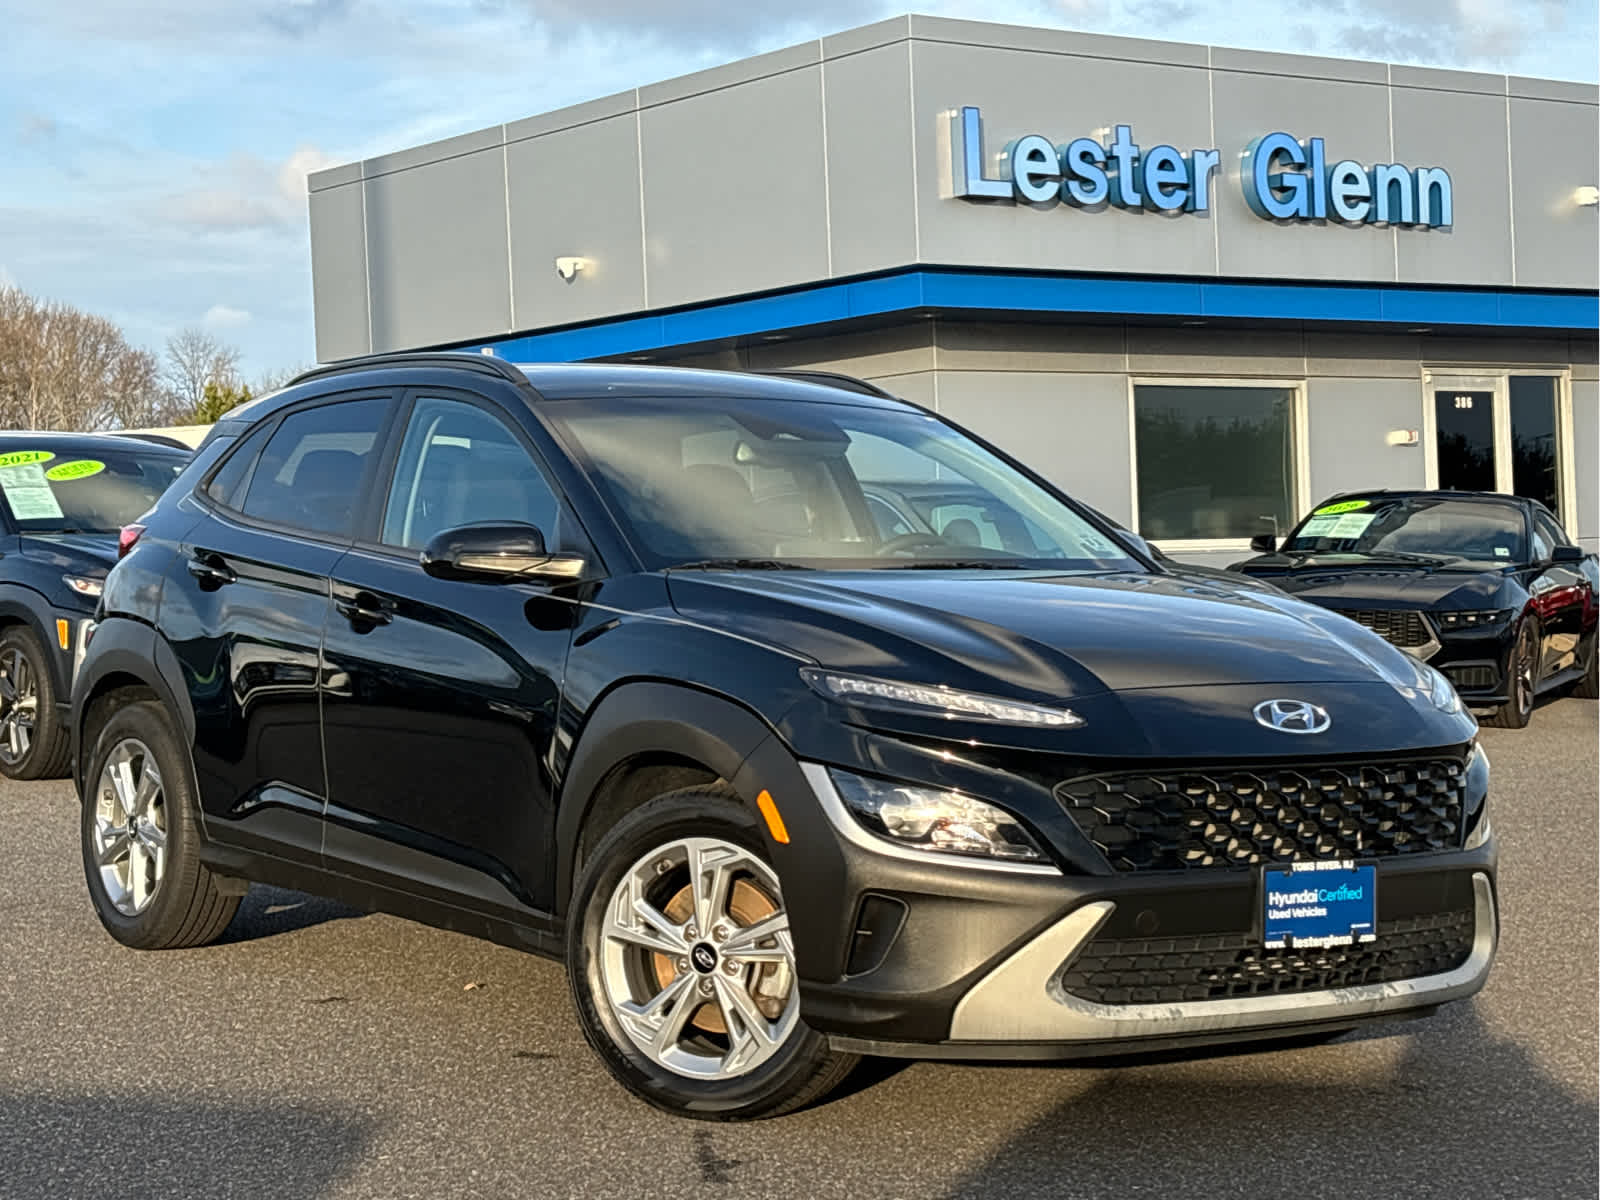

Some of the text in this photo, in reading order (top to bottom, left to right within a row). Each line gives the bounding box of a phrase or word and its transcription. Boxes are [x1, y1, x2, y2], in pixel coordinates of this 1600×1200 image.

[958, 105, 1453, 228] Lester Glenn
[0, 452, 40, 466] 2021
[1268, 883, 1362, 907] Hyundai Certified
[1268, 906, 1327, 919] Used Vehicles
